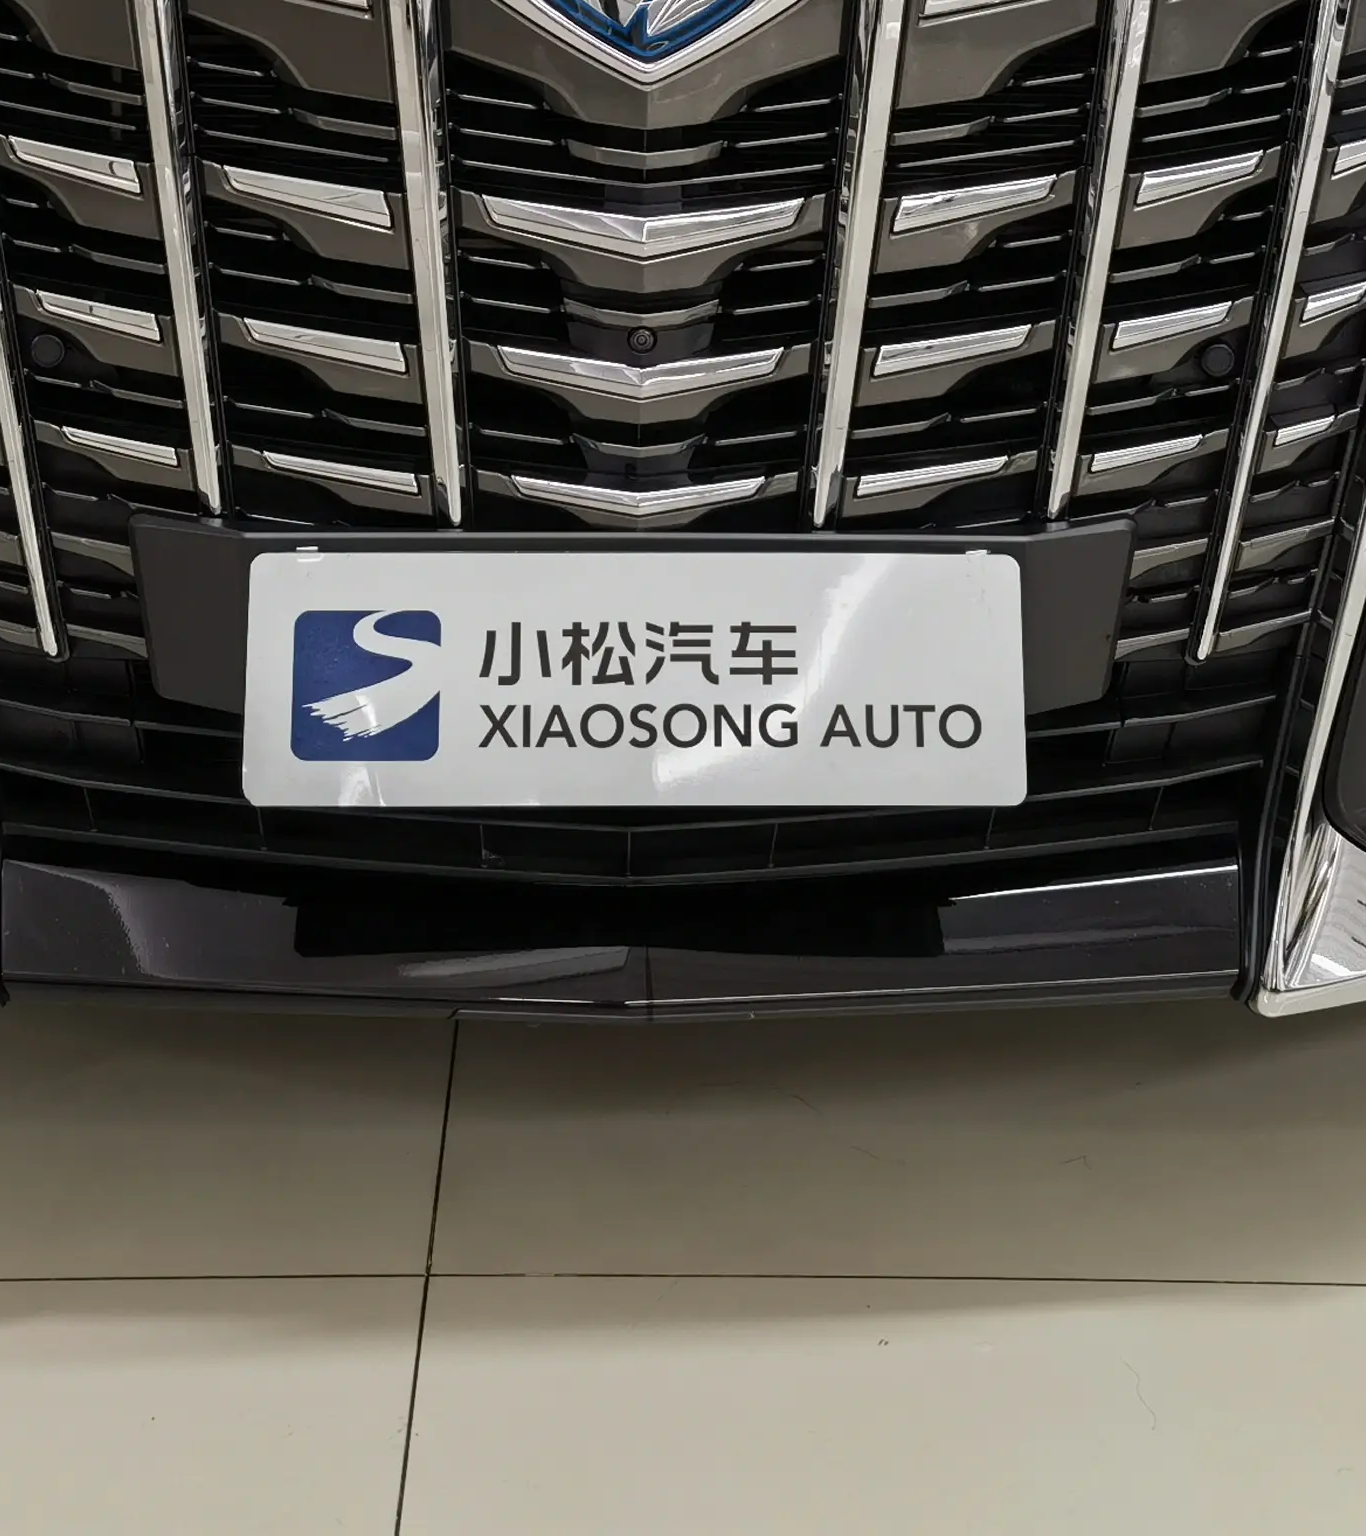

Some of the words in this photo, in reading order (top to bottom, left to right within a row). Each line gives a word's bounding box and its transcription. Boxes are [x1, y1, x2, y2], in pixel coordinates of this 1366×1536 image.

[478, 621, 799, 686] 小松汽车
[478, 703, 798, 749] XIAOSONG
[820, 703, 982, 749] AUTO
